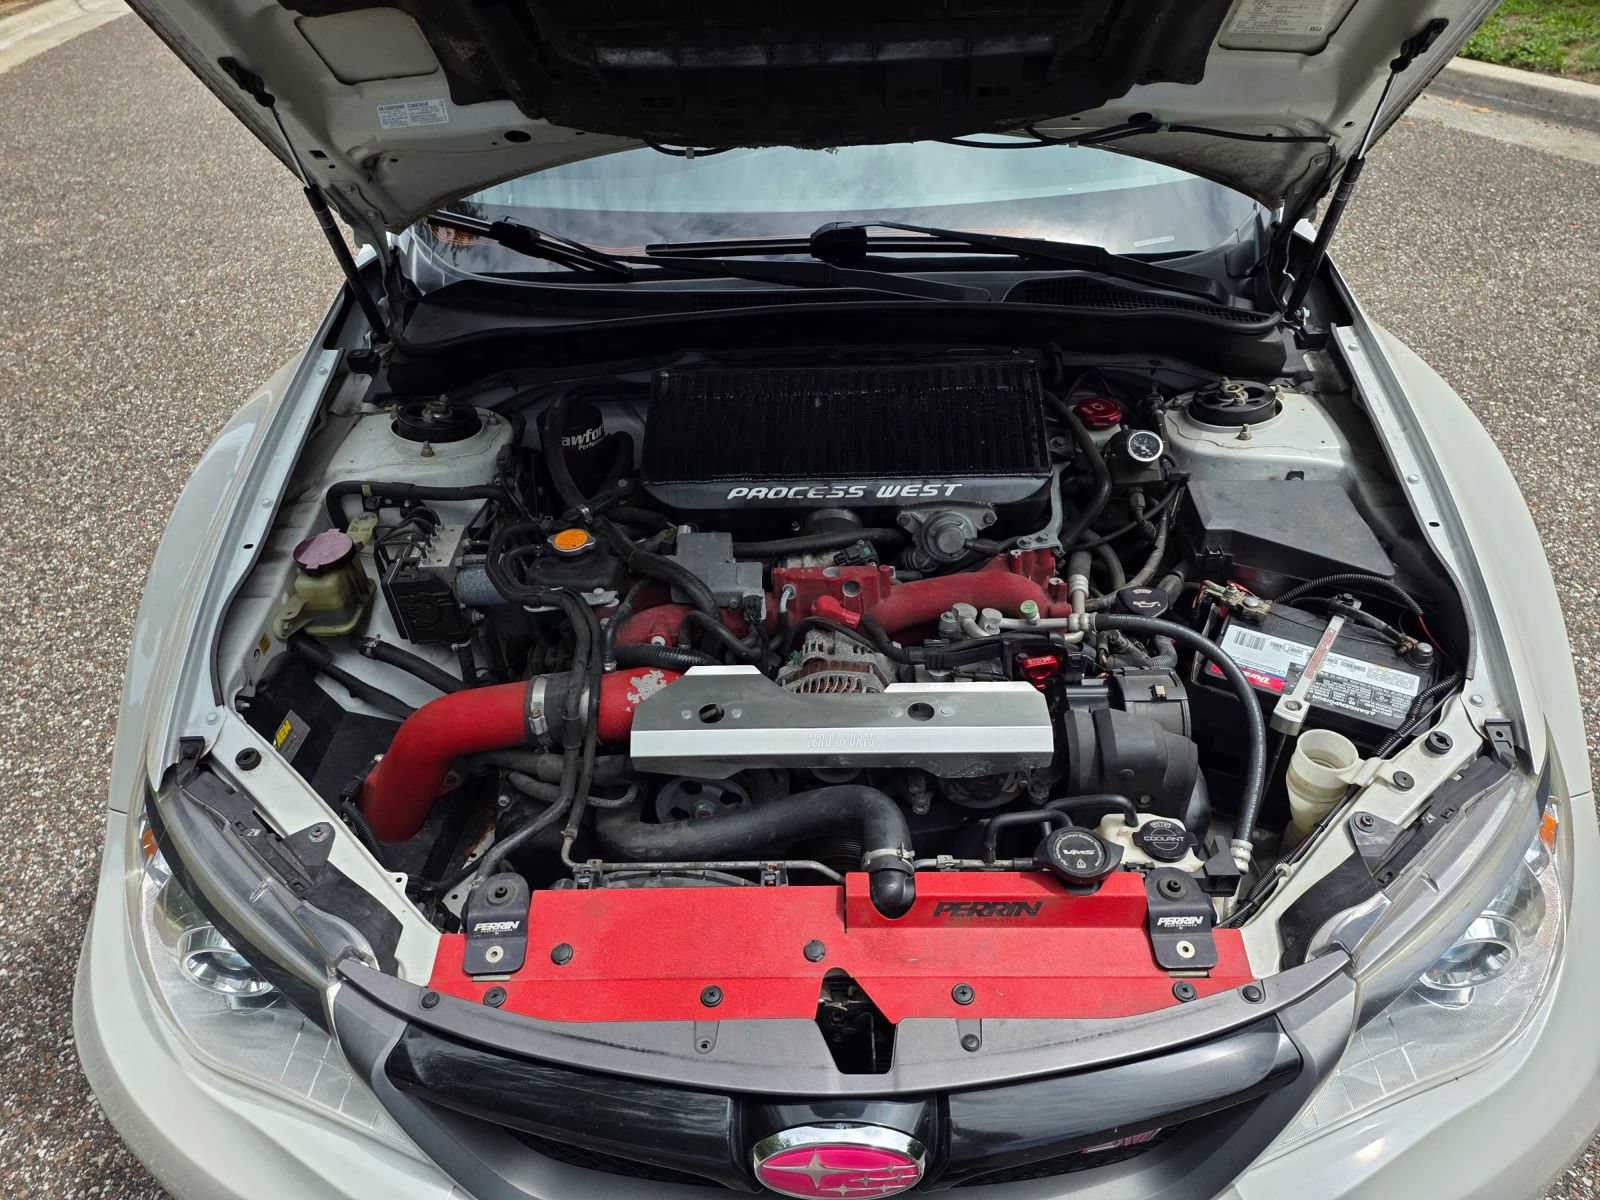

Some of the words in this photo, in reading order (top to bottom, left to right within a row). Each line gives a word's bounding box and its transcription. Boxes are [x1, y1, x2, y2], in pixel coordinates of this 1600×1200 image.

[727, 486, 867, 500] PROCESS
[876, 483, 963, 499] WEST
[1243, 670, 1271, 684] Dura
[933, 901, 1043, 918] PERRIN
[473, 920, 520, 931] PERRIN
[1157, 916, 1204, 926] PERRIN
